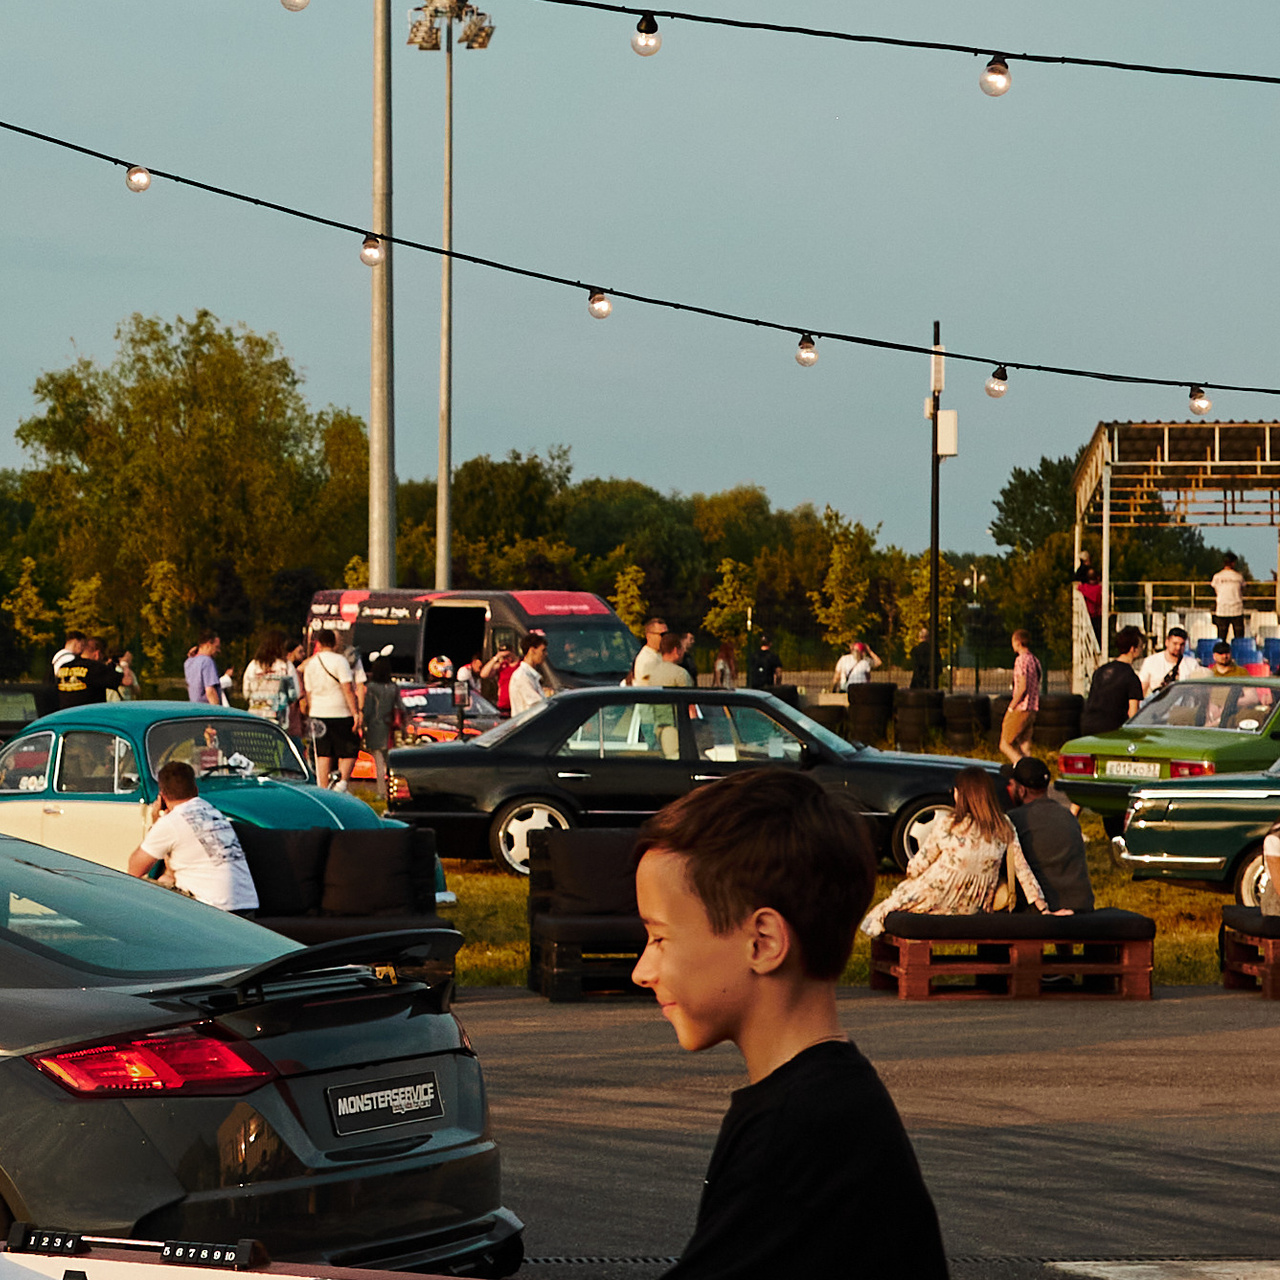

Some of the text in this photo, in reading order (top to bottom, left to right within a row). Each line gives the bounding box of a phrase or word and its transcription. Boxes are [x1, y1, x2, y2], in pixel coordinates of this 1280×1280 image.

[337, 1082, 435, 1116] MONSTERSERVICE
[30, 1236, 236, 1262] 1 2 3 4 5 6 7 8 9 10
